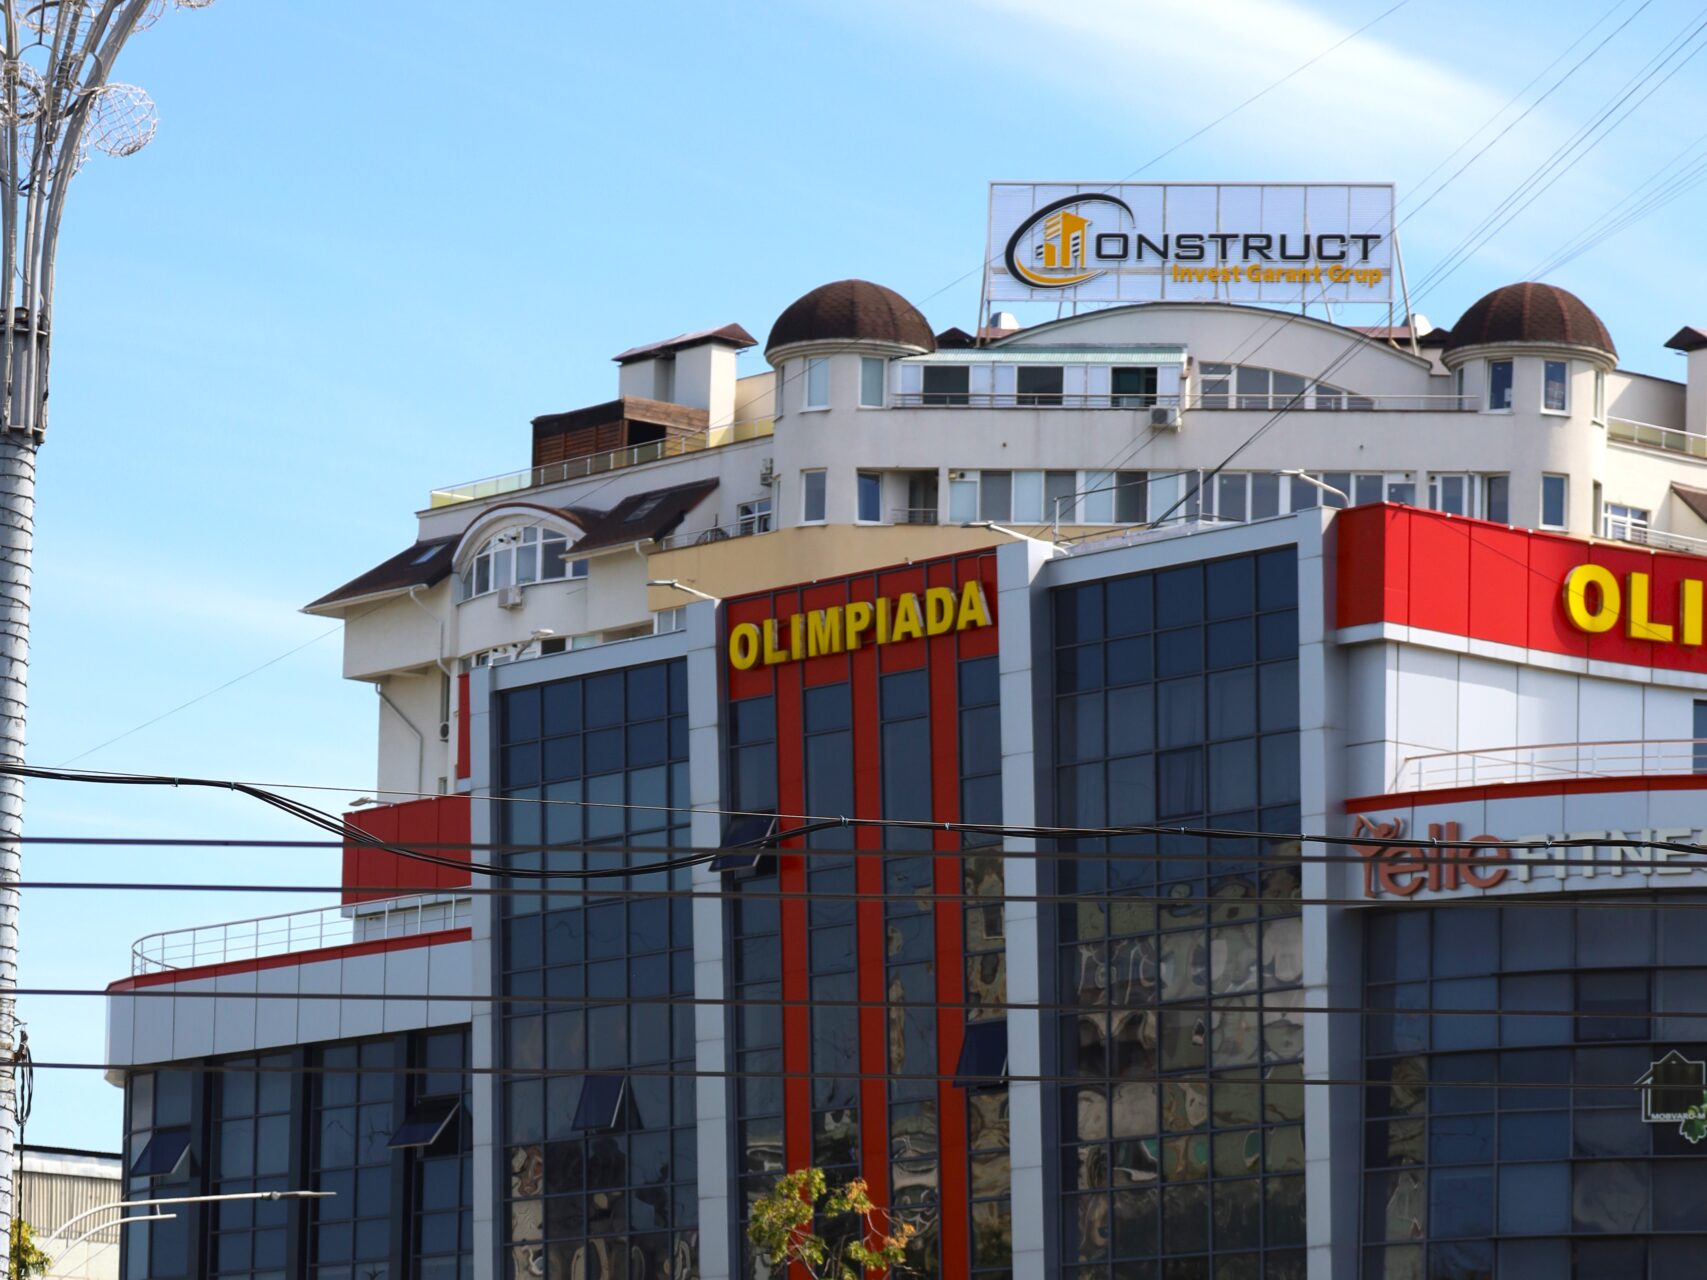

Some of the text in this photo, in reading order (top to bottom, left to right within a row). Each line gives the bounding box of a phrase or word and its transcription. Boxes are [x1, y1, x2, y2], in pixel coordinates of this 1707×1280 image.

[1173, 264, 1382, 288] Invest Garant Grup
[729, 580, 993, 671] OLIMPIADA
[1517, 827, 1707, 884] FITNE
